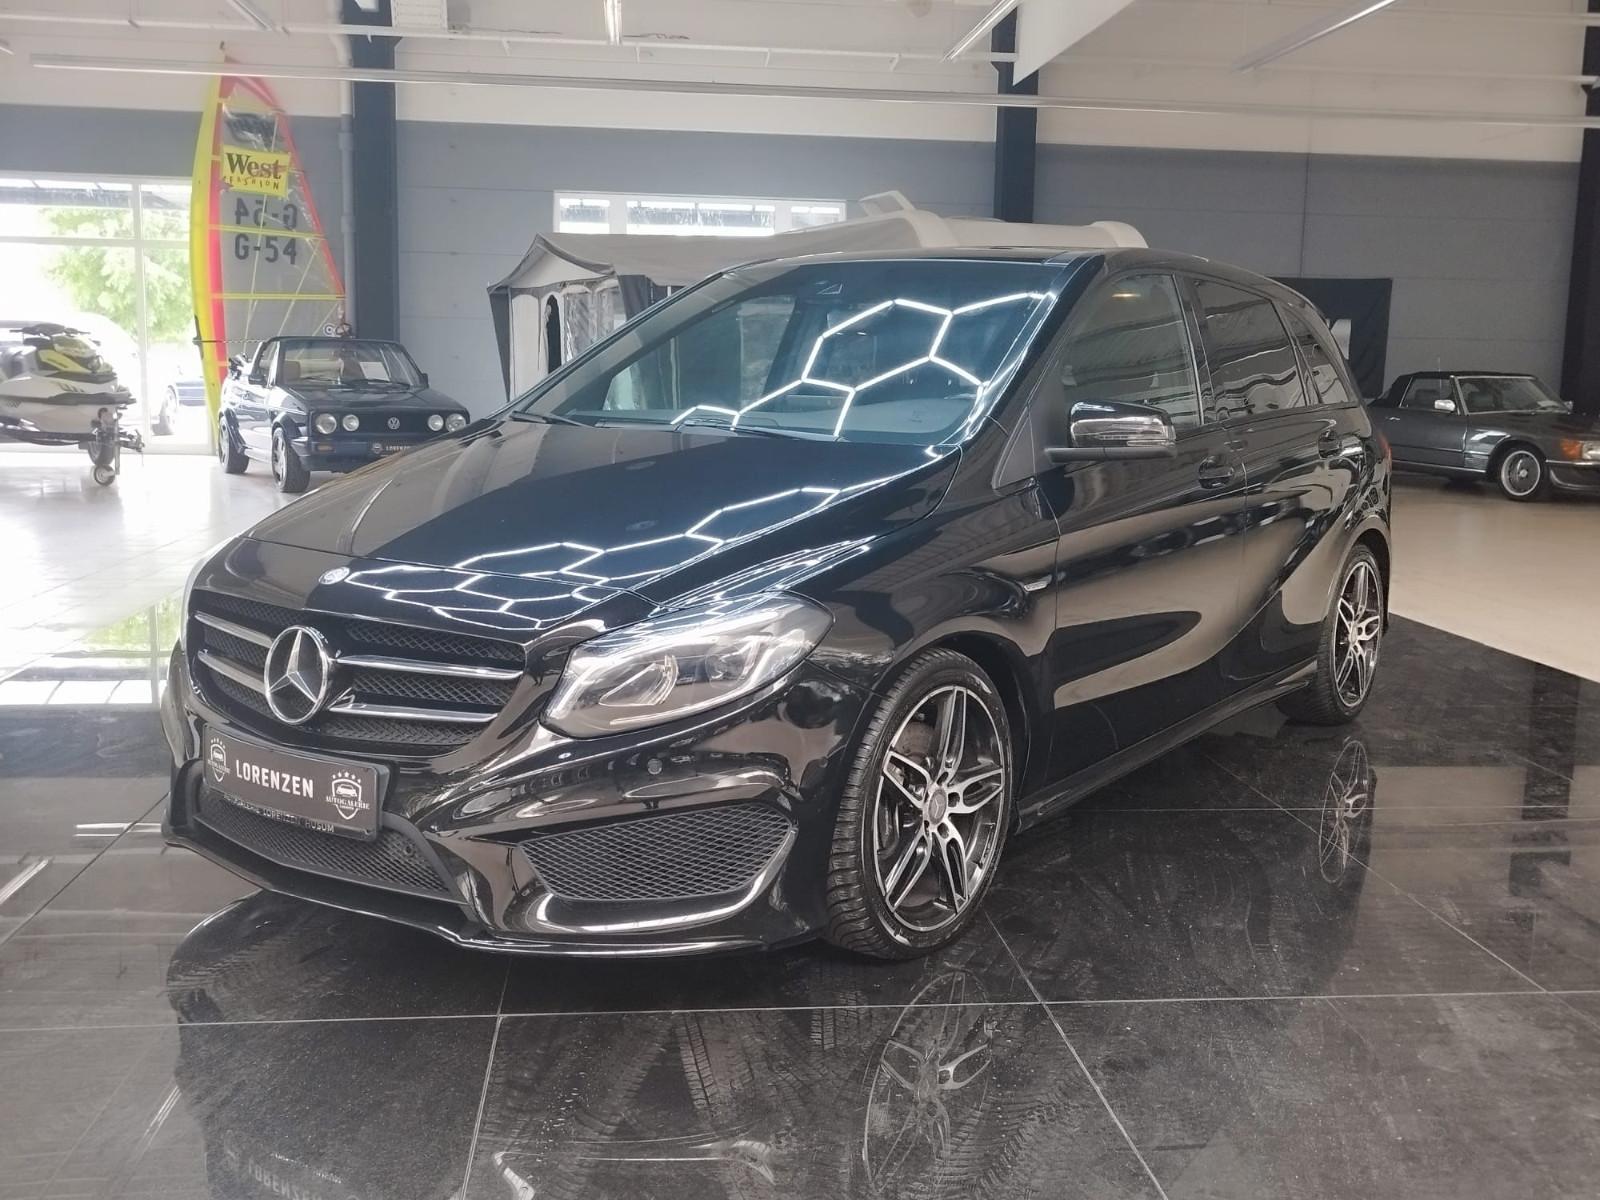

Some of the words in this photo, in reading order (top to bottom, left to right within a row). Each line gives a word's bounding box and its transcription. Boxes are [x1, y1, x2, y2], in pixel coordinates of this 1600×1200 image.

[226, 153, 282, 180] West
[234, 233, 297, 265] G-54
[235, 759, 314, 799] LORENZEN
[304, 817, 335, 833] HUSUM
